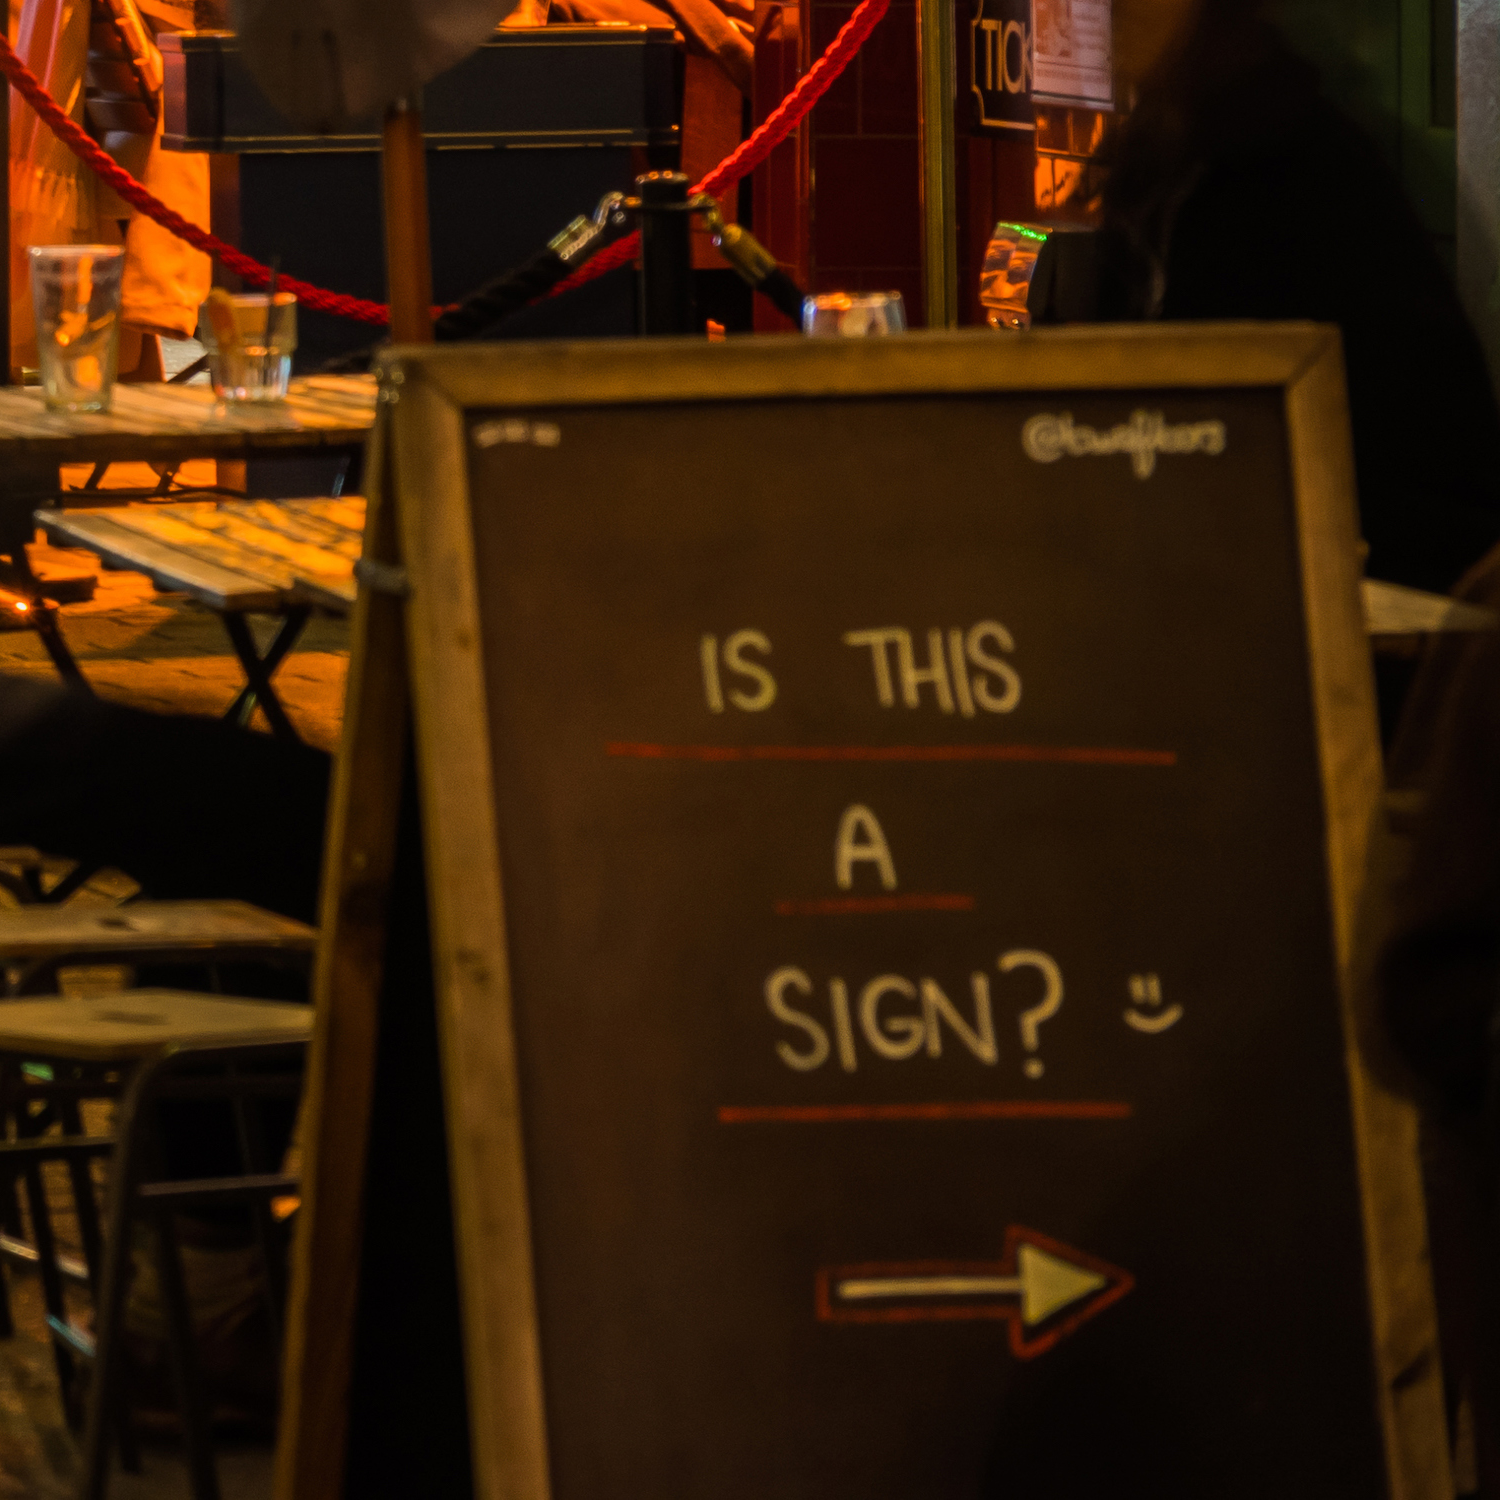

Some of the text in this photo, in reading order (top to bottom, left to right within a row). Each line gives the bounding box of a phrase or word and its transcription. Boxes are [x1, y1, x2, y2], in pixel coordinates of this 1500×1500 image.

[700, 620, 1023, 719] IS THIS
[834, 803, 897, 890] A
[764, 949, 1065, 1079] SIGN?
